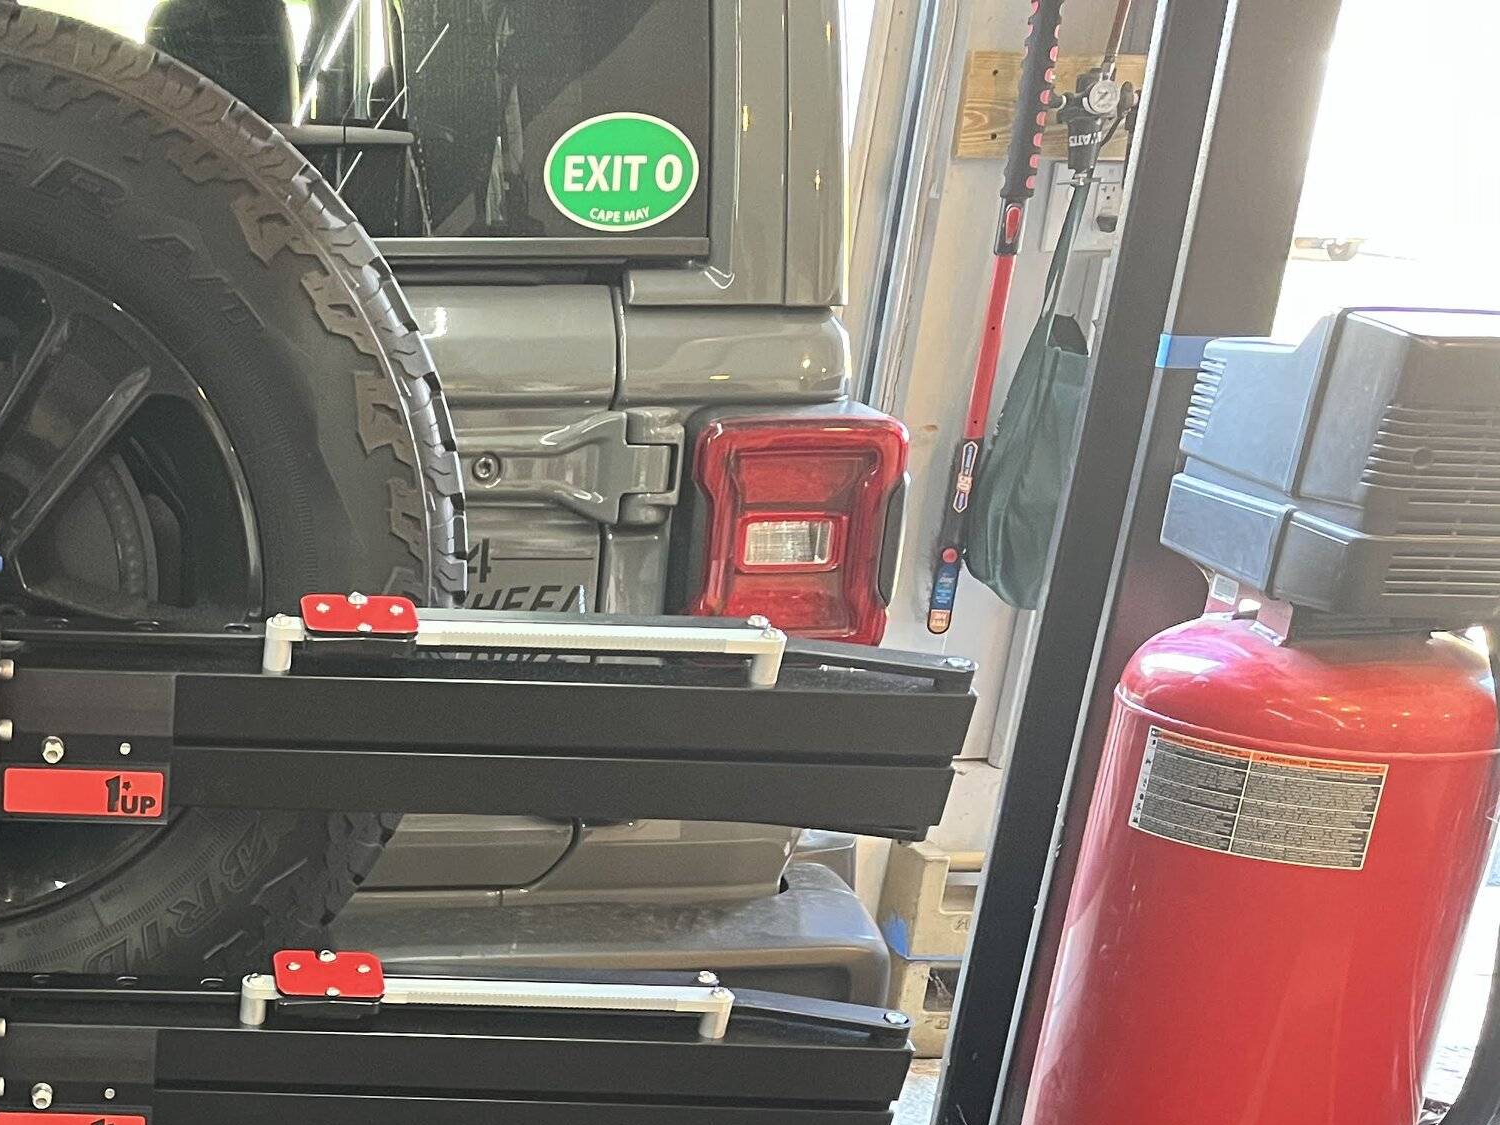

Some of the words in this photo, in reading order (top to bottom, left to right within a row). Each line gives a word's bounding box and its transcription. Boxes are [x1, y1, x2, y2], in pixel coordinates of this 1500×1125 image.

[563, 154, 648, 192] EXIT
[589, 207, 621, 223] CAPE
[624, 206, 650, 223] MAY
[105, 774, 156, 815] 1UP
